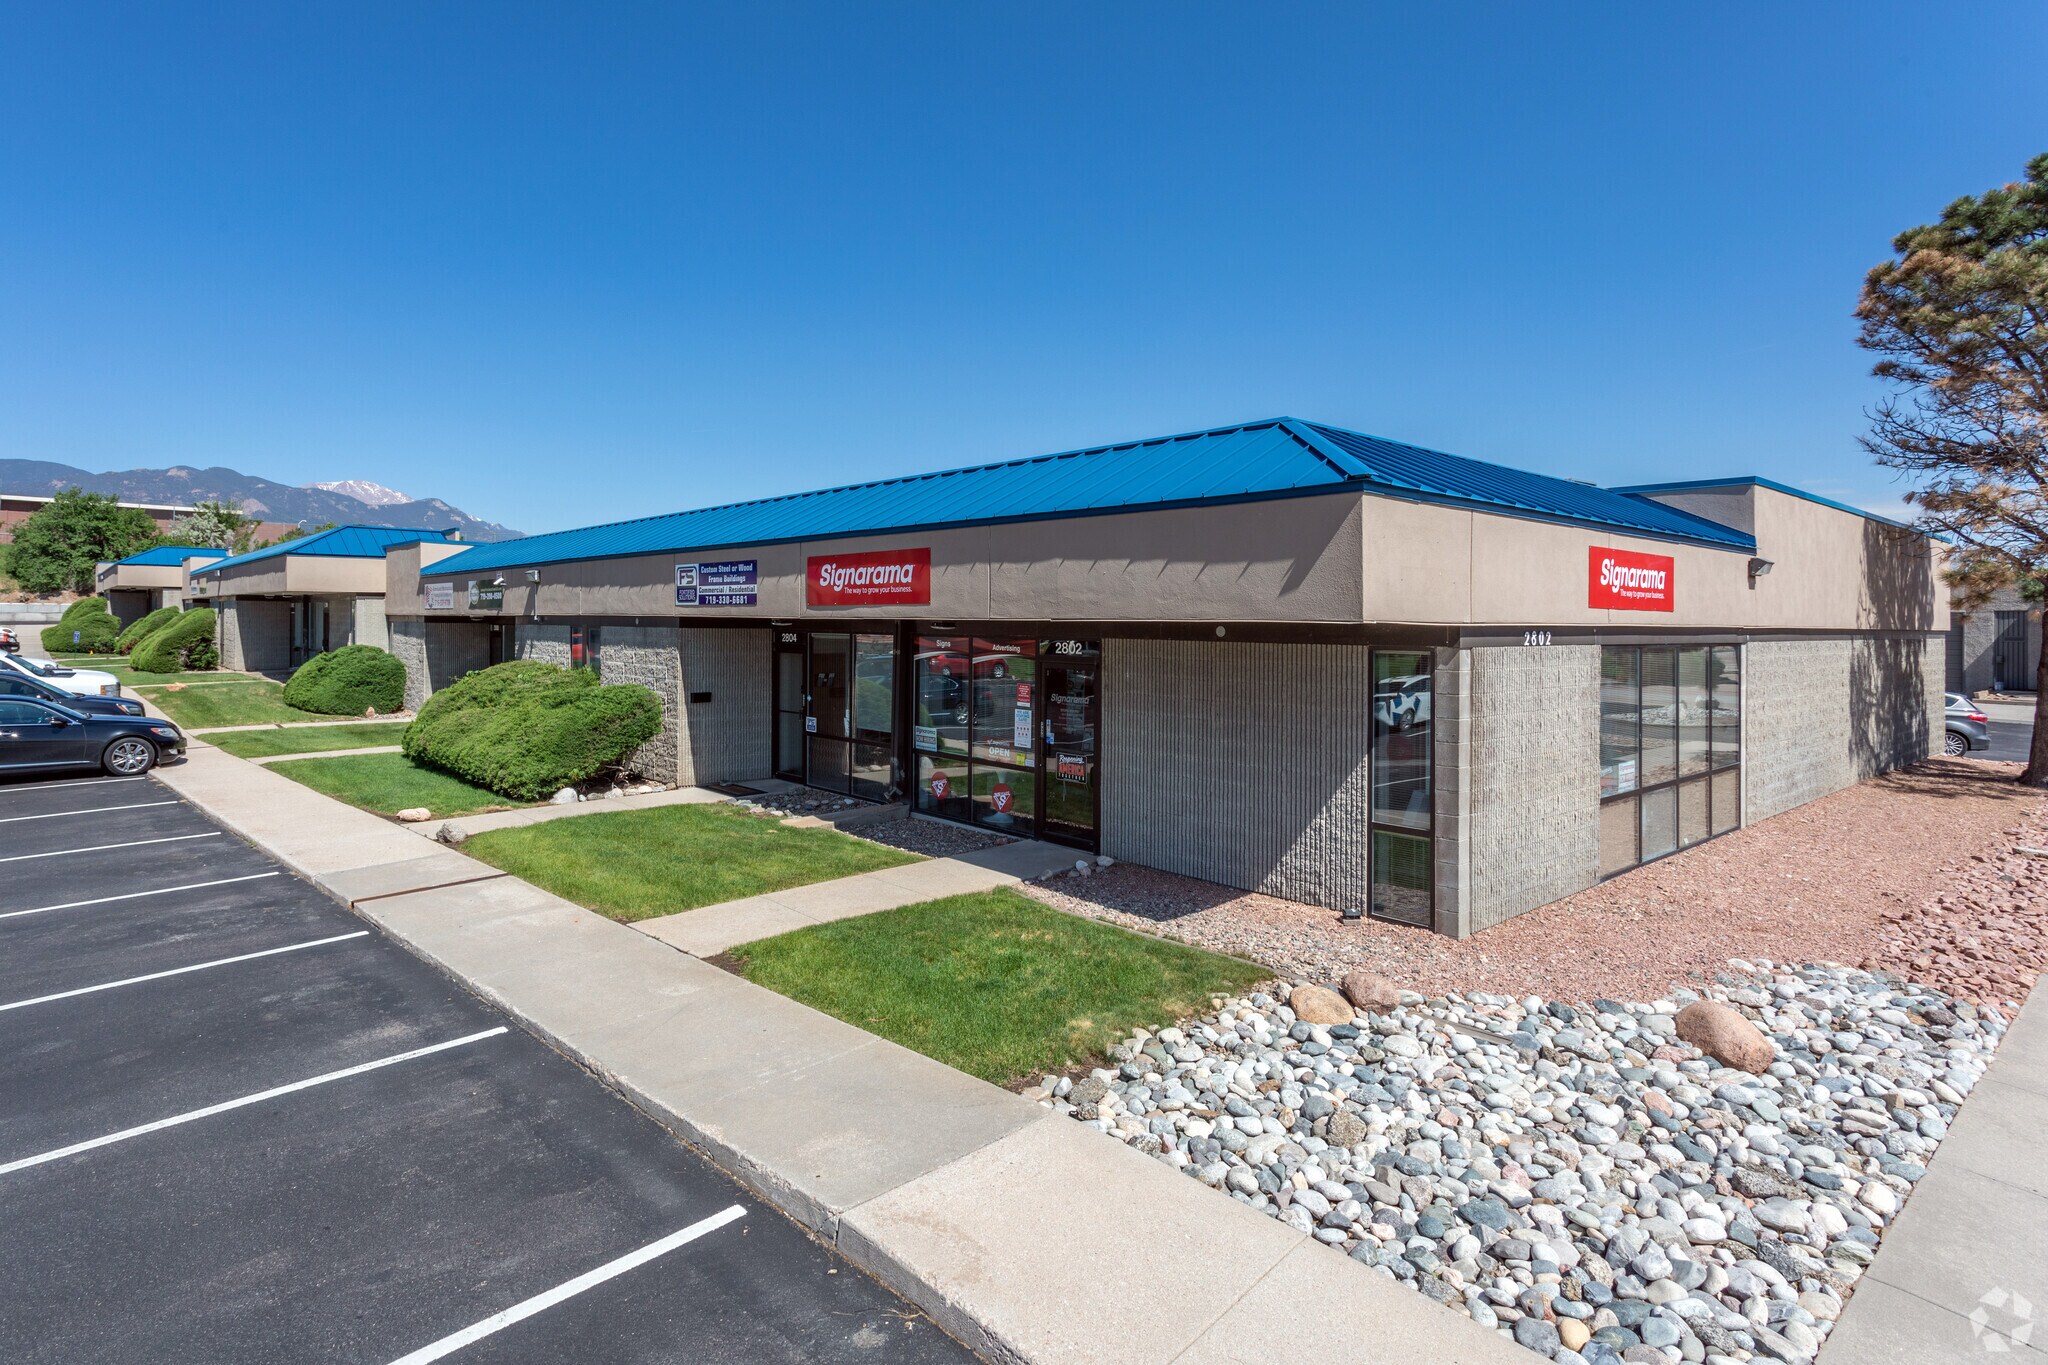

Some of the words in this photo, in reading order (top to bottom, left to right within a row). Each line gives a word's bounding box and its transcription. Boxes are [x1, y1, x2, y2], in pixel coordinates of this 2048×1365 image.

[719, 564, 731, 573] Steel
[738, 563, 753, 571] Wood
[709, 575, 723, 583] Frame
[724, 574, 746, 583] Buildings
[819, 563, 914, 592] Signarama
[1600, 558, 1666, 593] Signarama
[729, 585, 756, 593] Residential
[844, 586, 853, 594] The
[868, 587, 879, 595] grow
[879, 587, 891, 595] your
[890, 585, 913, 593] business.
[782, 633, 797, 642] 2804
[1524, 631, 1551, 646] 2802
[936, 640, 951, 648] Signs
[992, 644, 1020, 653] Advertising
[1055, 642, 1083, 655] 2802
[1051, 694, 1090, 704] Signarama
[988, 746, 1010, 757] OPEN
